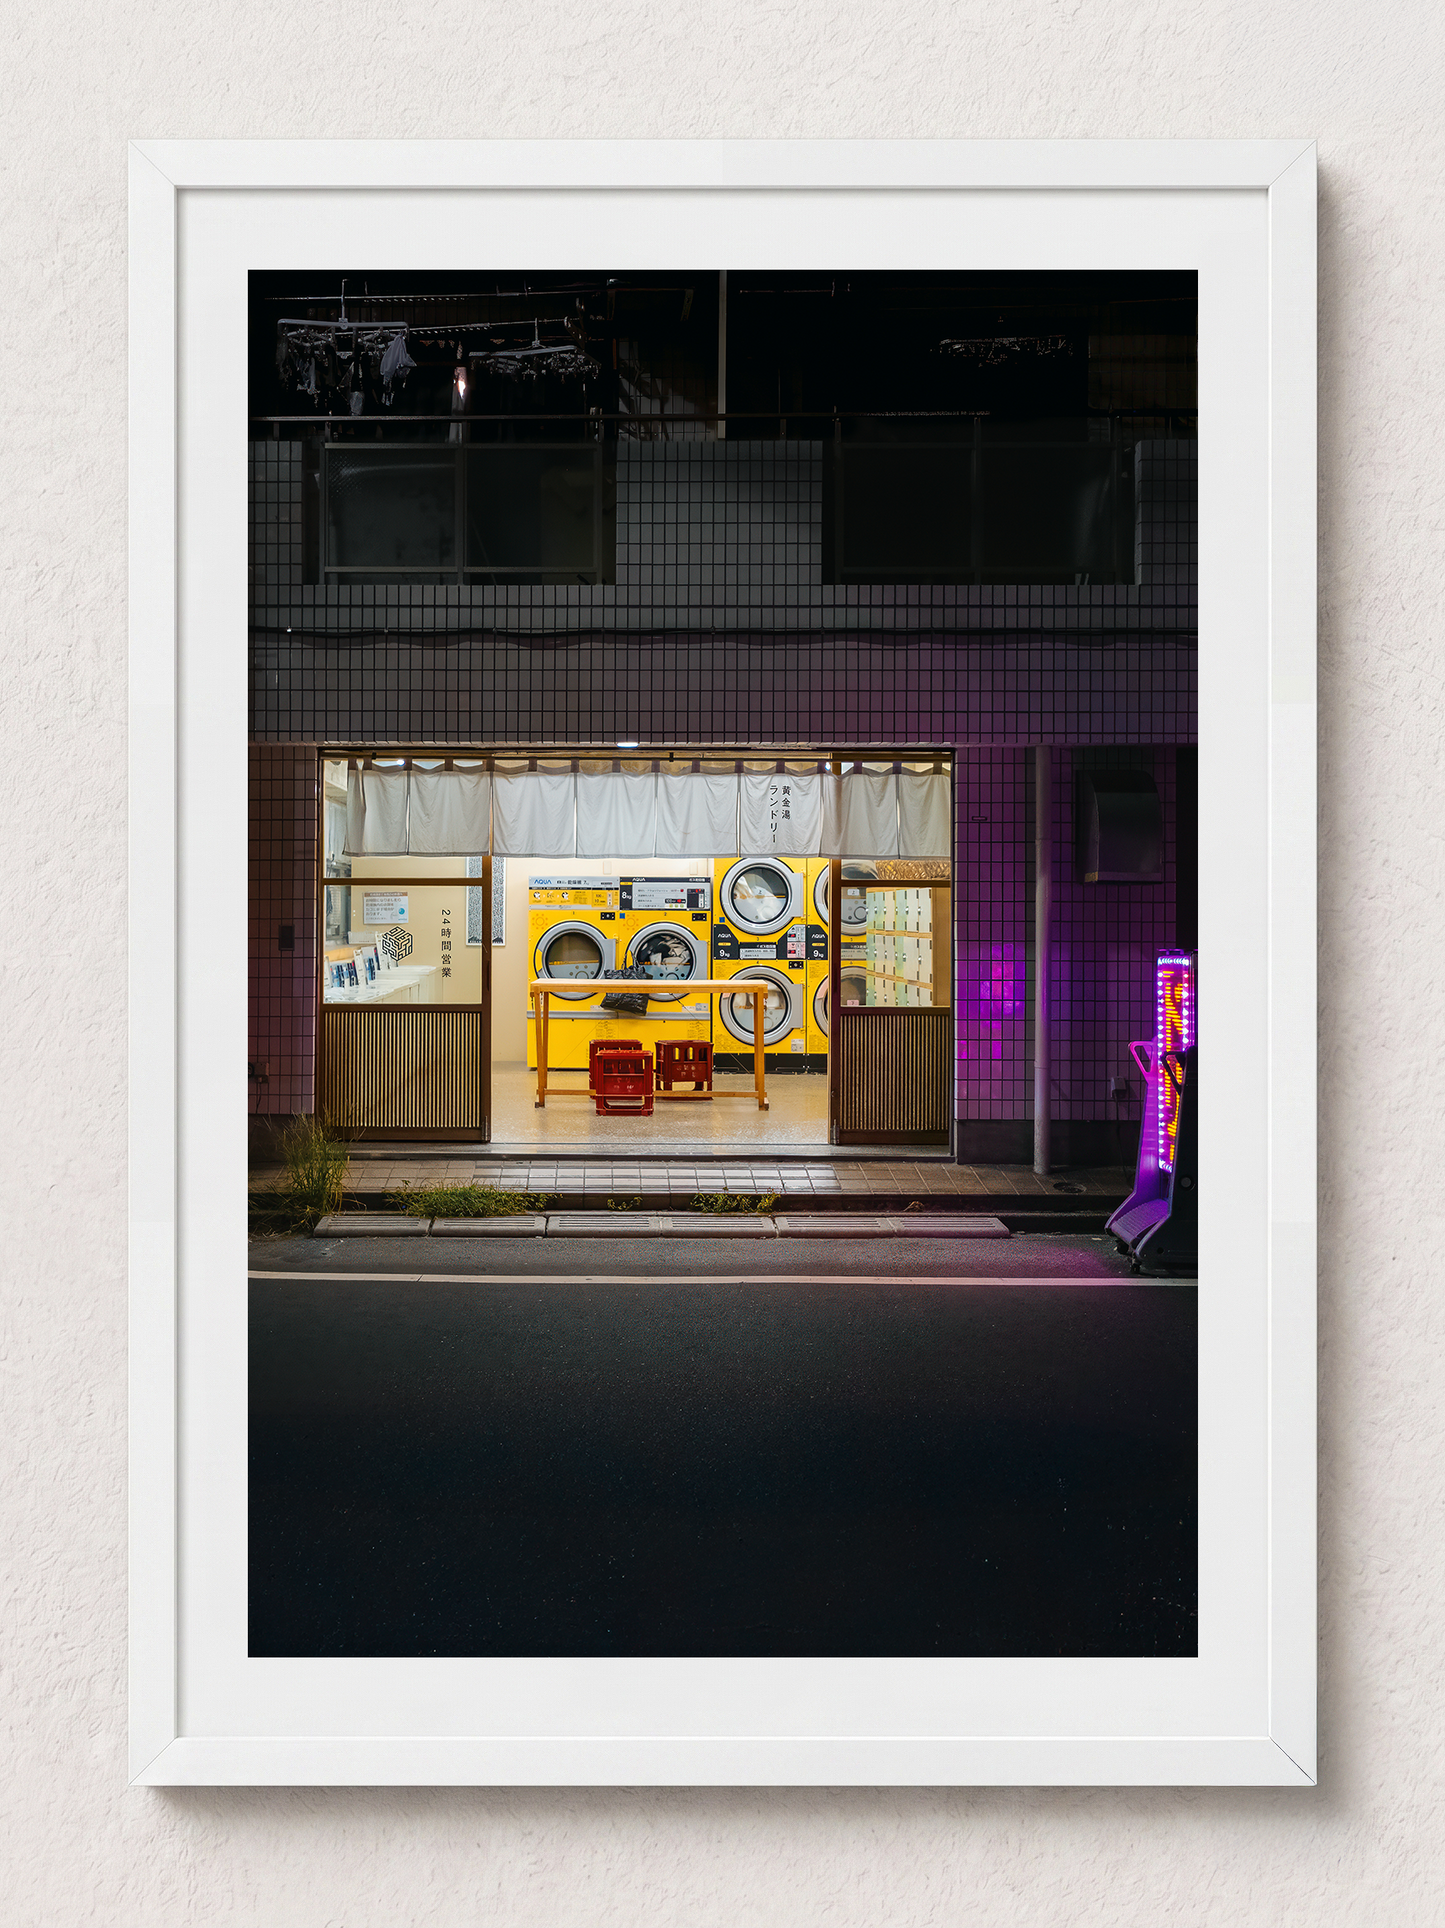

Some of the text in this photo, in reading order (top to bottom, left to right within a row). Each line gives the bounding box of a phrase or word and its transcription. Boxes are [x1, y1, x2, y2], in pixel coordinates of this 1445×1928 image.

[770, 785, 779, 843] ランドリー
[781, 785, 791, 820] 黄金湯
[441, 909, 452, 978] 24時間営業
[719, 949, 730, 958] 9kg
[813, 949, 825, 958] 9kg
